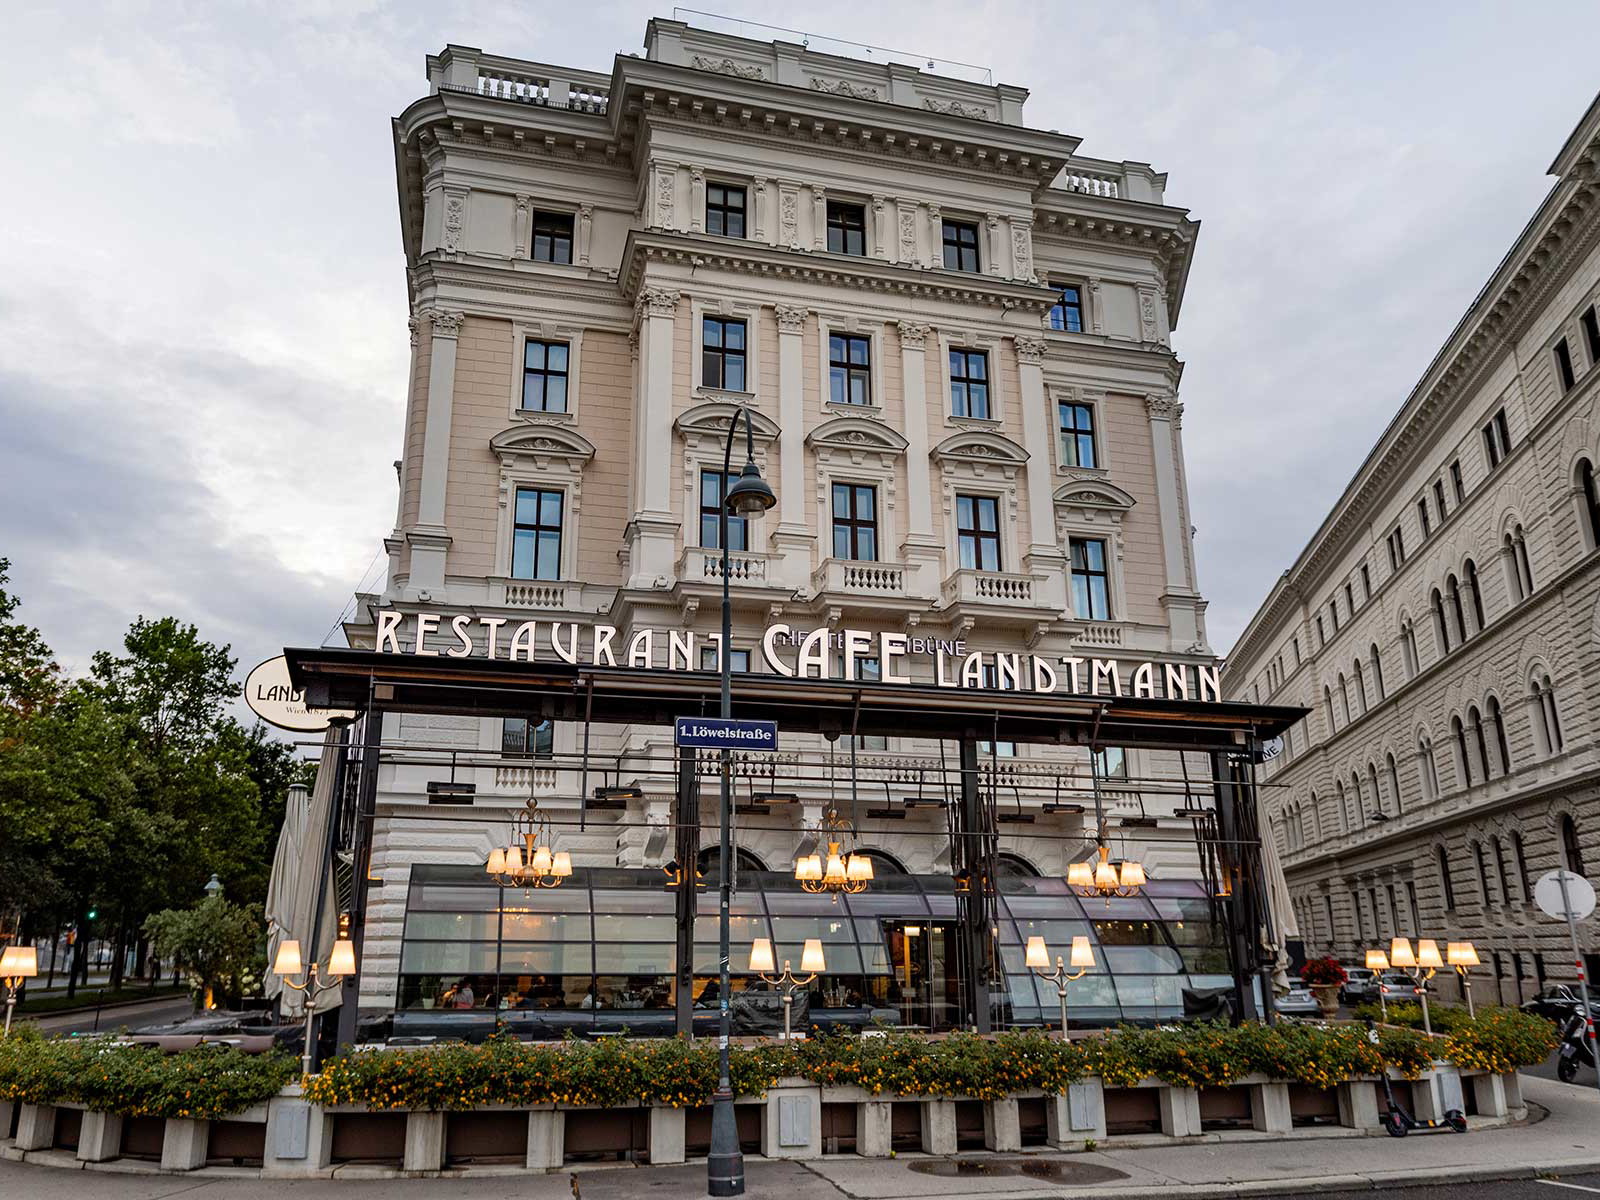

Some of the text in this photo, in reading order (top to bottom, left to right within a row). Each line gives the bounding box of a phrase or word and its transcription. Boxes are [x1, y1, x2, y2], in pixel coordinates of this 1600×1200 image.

[375, 610, 1222, 703] RESTAURANT CAFE LANDTMANN
[692, 725, 772, 740] Löwelstraße
